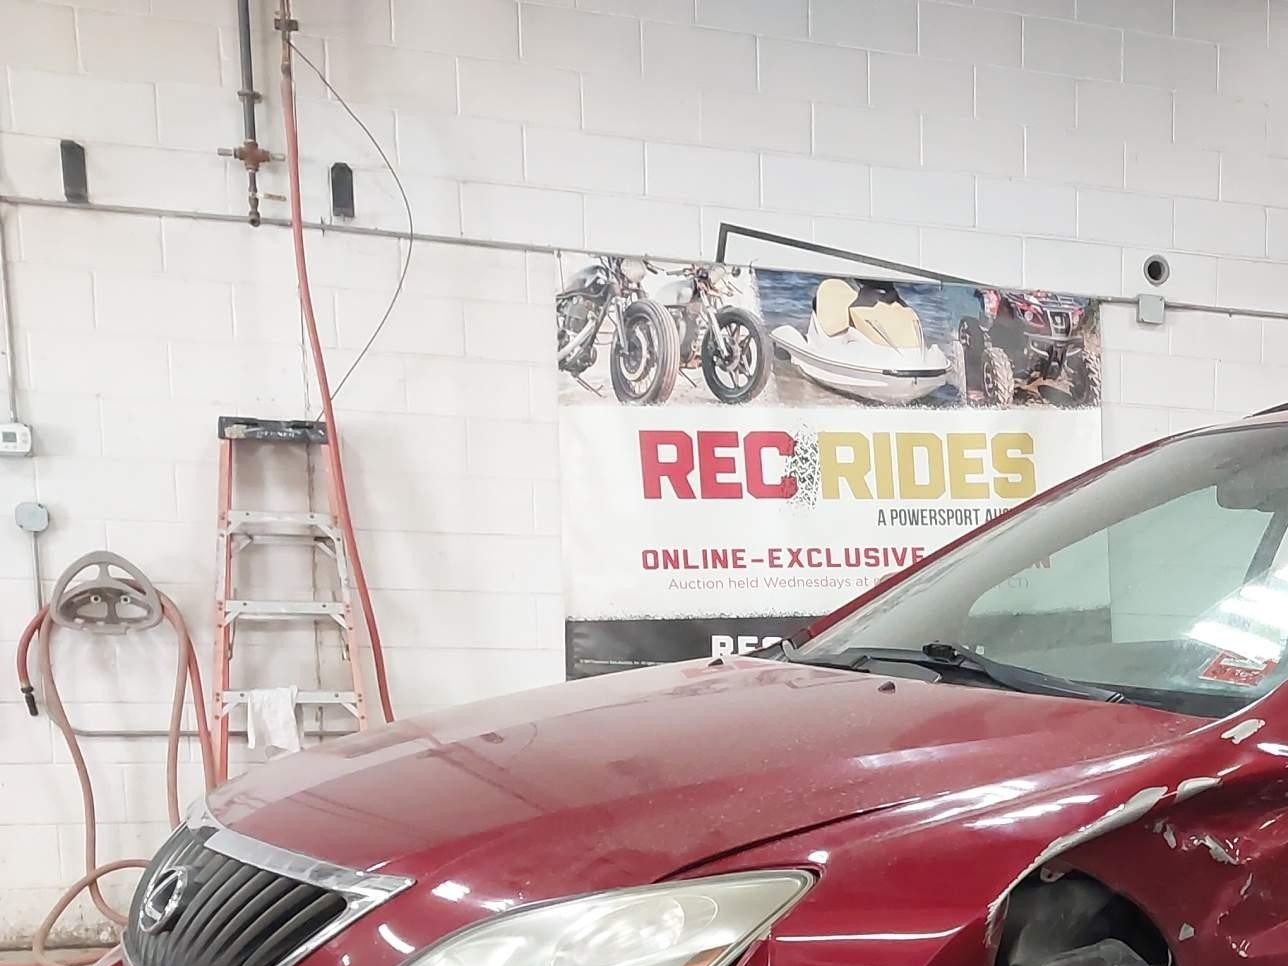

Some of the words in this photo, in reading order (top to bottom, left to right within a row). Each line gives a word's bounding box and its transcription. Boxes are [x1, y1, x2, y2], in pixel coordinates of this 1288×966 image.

[638, 430, 799, 500] REC
[818, 432, 1035, 500] RIDES
[877, 508, 887, 526] A
[890, 508, 981, 526] POWERSPORT
[641, 546, 926, 570] ONLINE-EXCLUSIVE
[668, 577, 723, 591] Auction
[728, 576, 759, 590] held
[764, 575, 851, 590] Wednesdays
[855, 577, 869, 588] at
